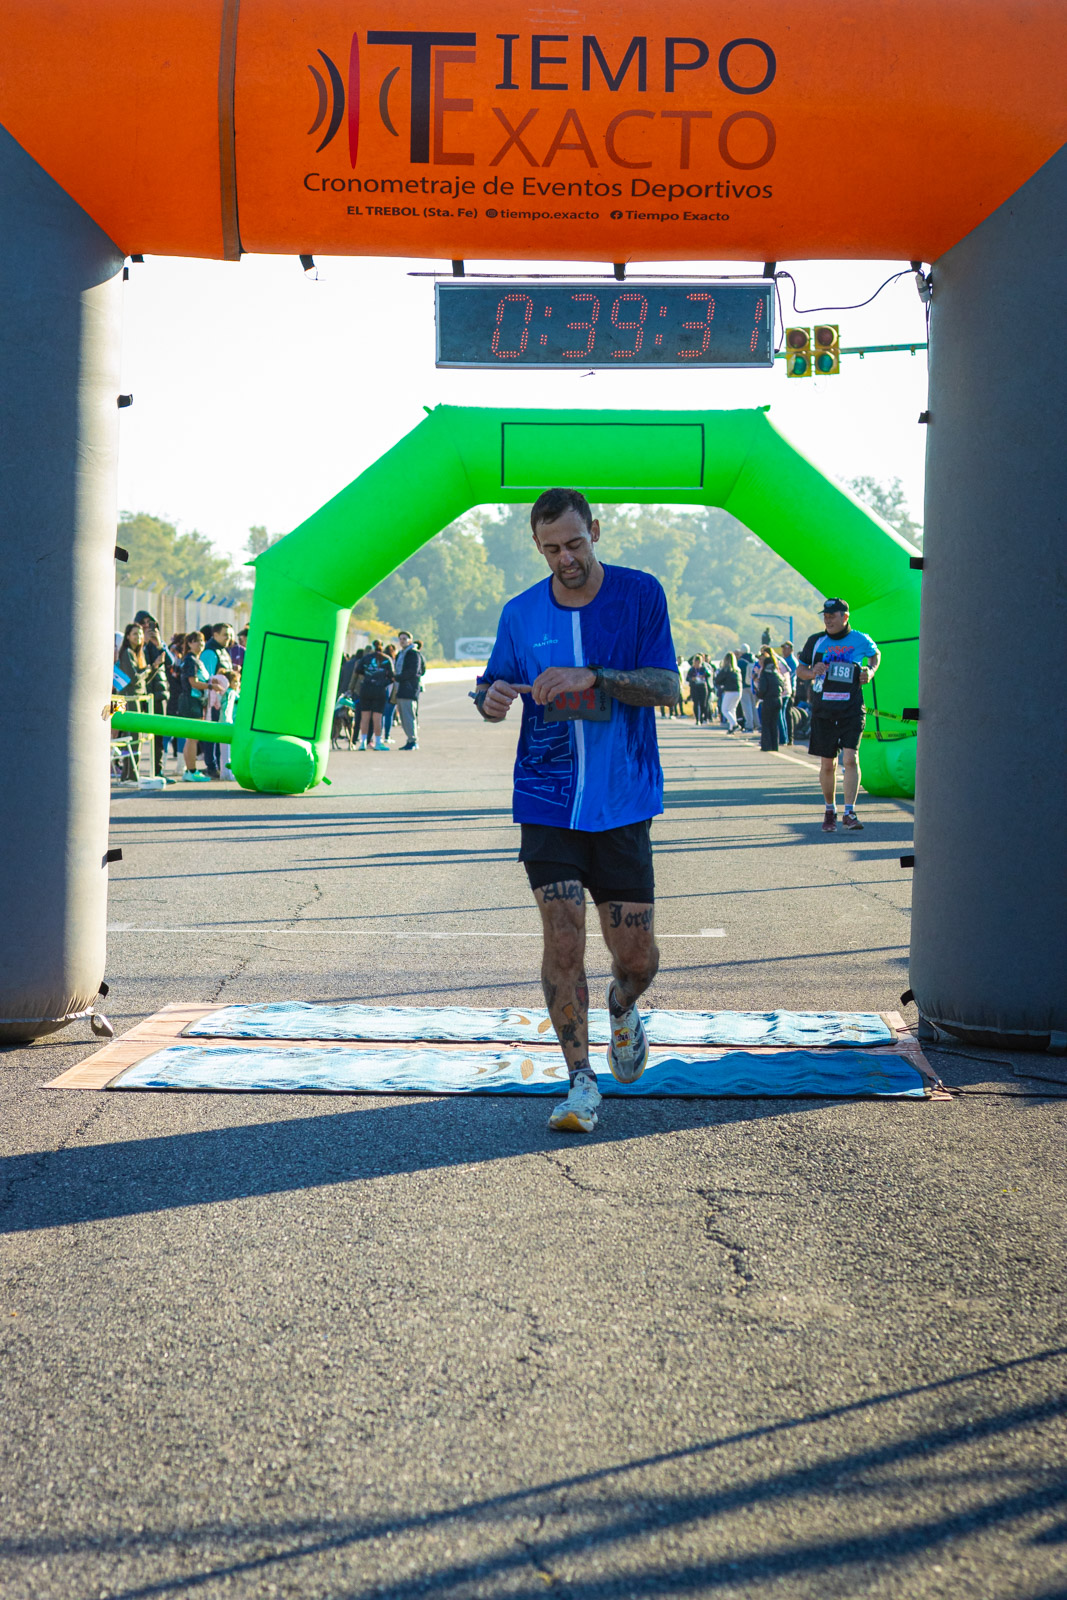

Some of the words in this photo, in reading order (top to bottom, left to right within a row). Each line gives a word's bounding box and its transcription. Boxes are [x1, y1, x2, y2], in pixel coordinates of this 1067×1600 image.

[303, 172, 476, 199] Cronometraje
[482, 176, 514, 195] de
[522, 177, 622, 197] Eventos
[631, 178, 773, 202] Deportivos
[347, 206, 363, 215] EL
[365, 206, 420, 217] TREBOL
[423, 207, 454, 218] (Sta.
[457, 208, 478, 218] Fe)
[500, 209, 599, 221] tiempo.exacto
[625, 210, 679, 222] Tiempo
[683, 211, 730, 221] Exacto
[833, 665, 850, 678] 158
